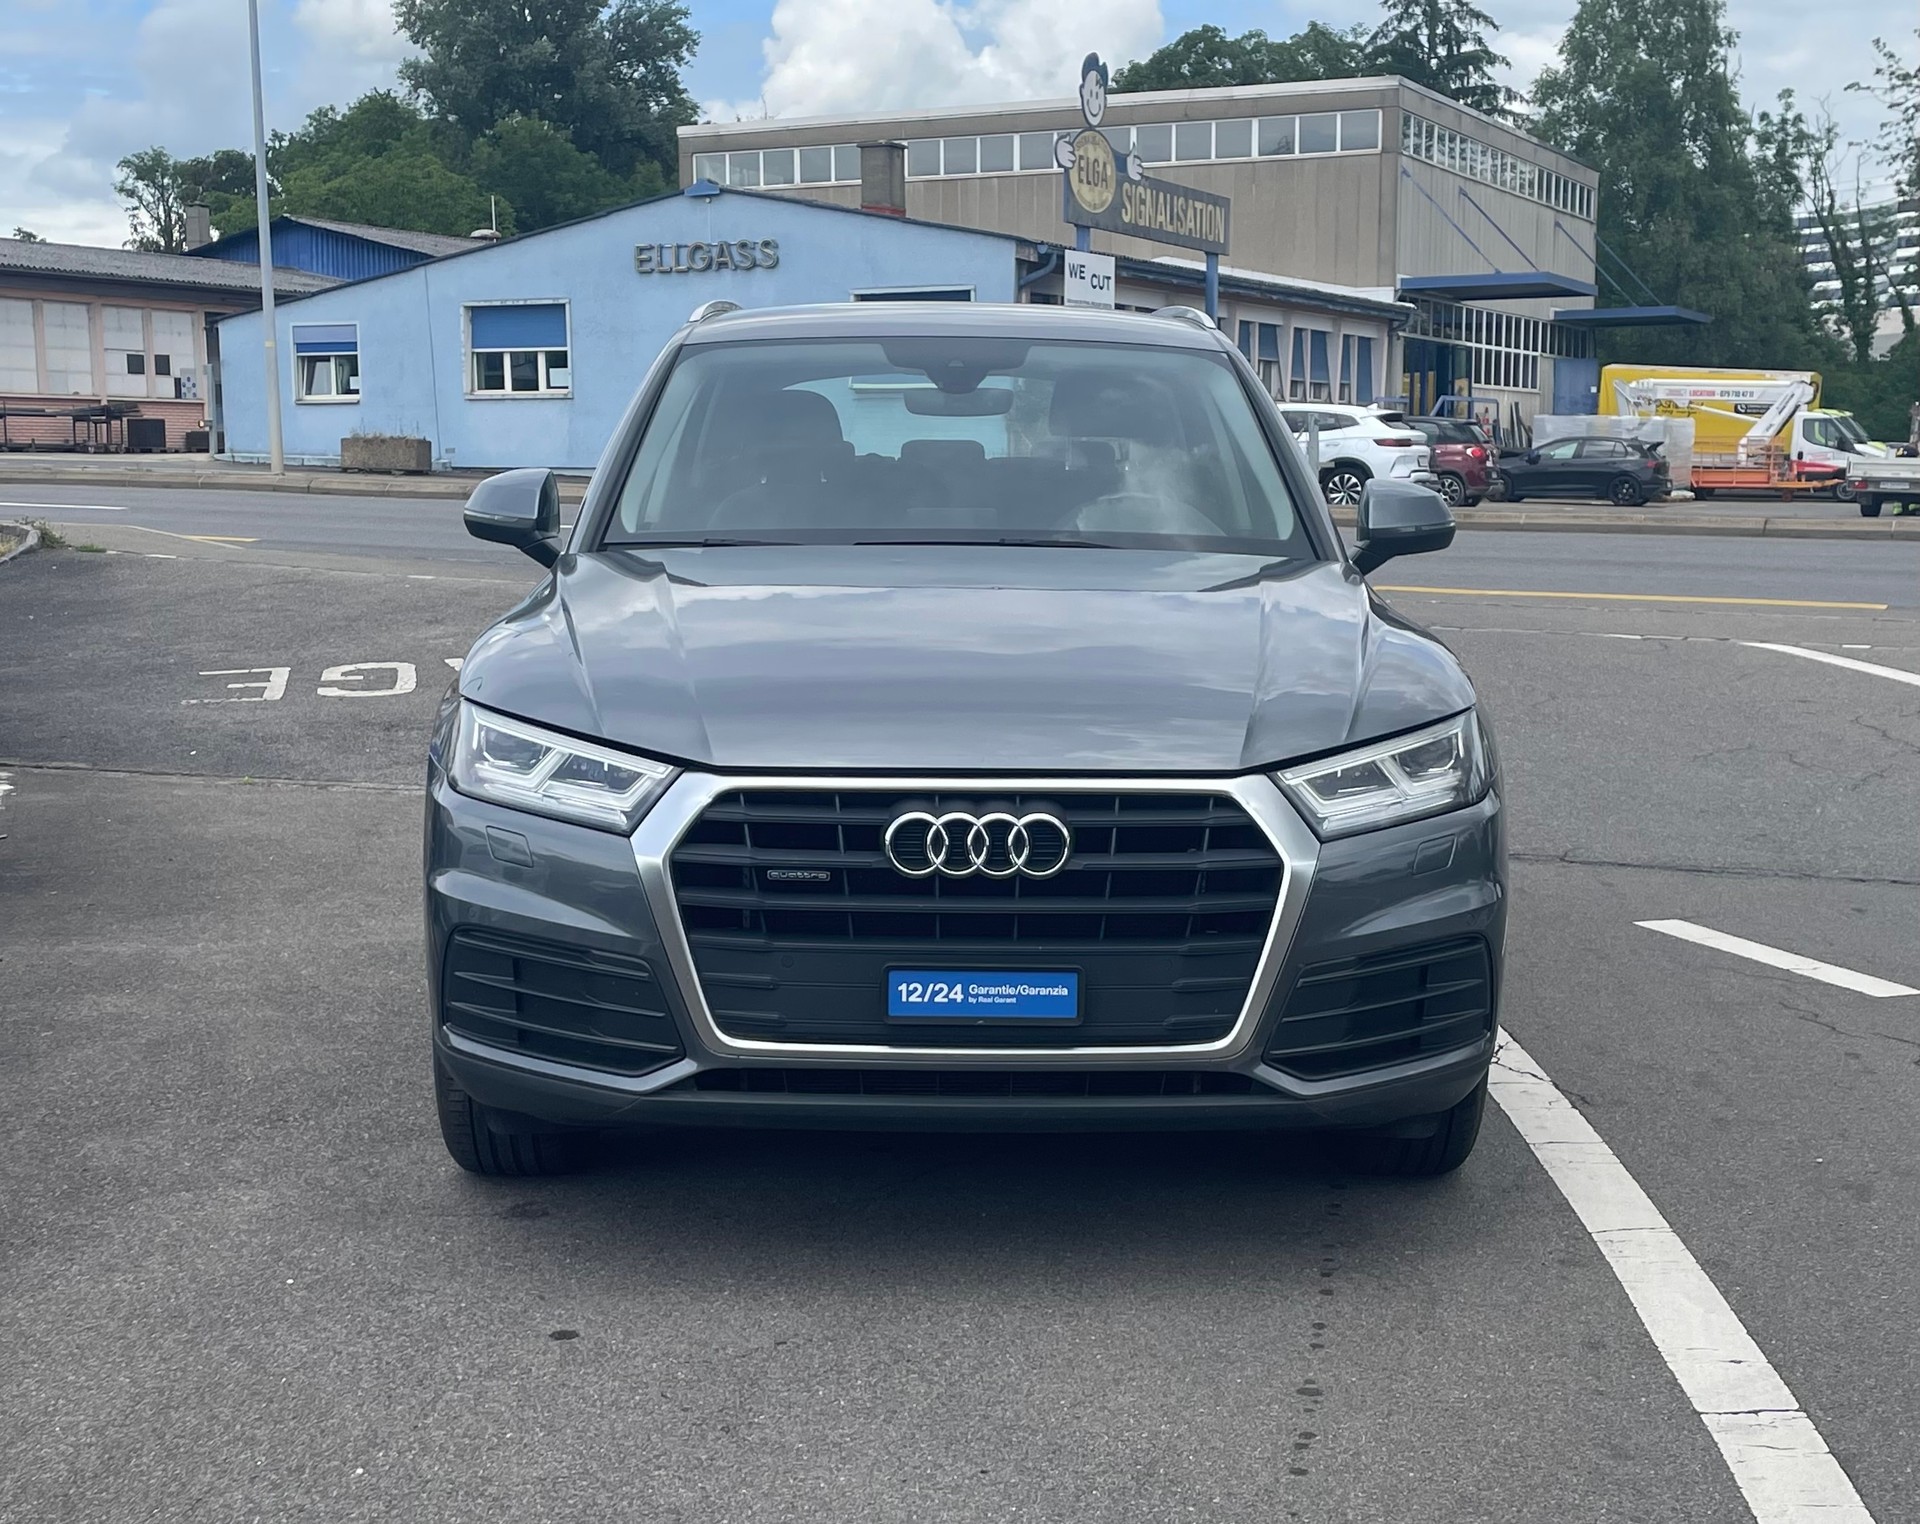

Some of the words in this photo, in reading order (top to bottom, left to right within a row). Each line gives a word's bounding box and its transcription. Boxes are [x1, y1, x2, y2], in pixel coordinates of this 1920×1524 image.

[1078, 155, 1108, 190] ELGA
[1121, 182, 1225, 243] SIGNALISATION
[634, 238, 779, 273] ELLGASS
[1068, 262, 1086, 280] WE
[1090, 273, 1112, 291] CUT
[770, 871, 827, 879] quattro
[898, 982, 964, 1003] 12/24
[968, 984, 1068, 996] Garantie/Garanzia
[968, 996, 977, 1004] by
